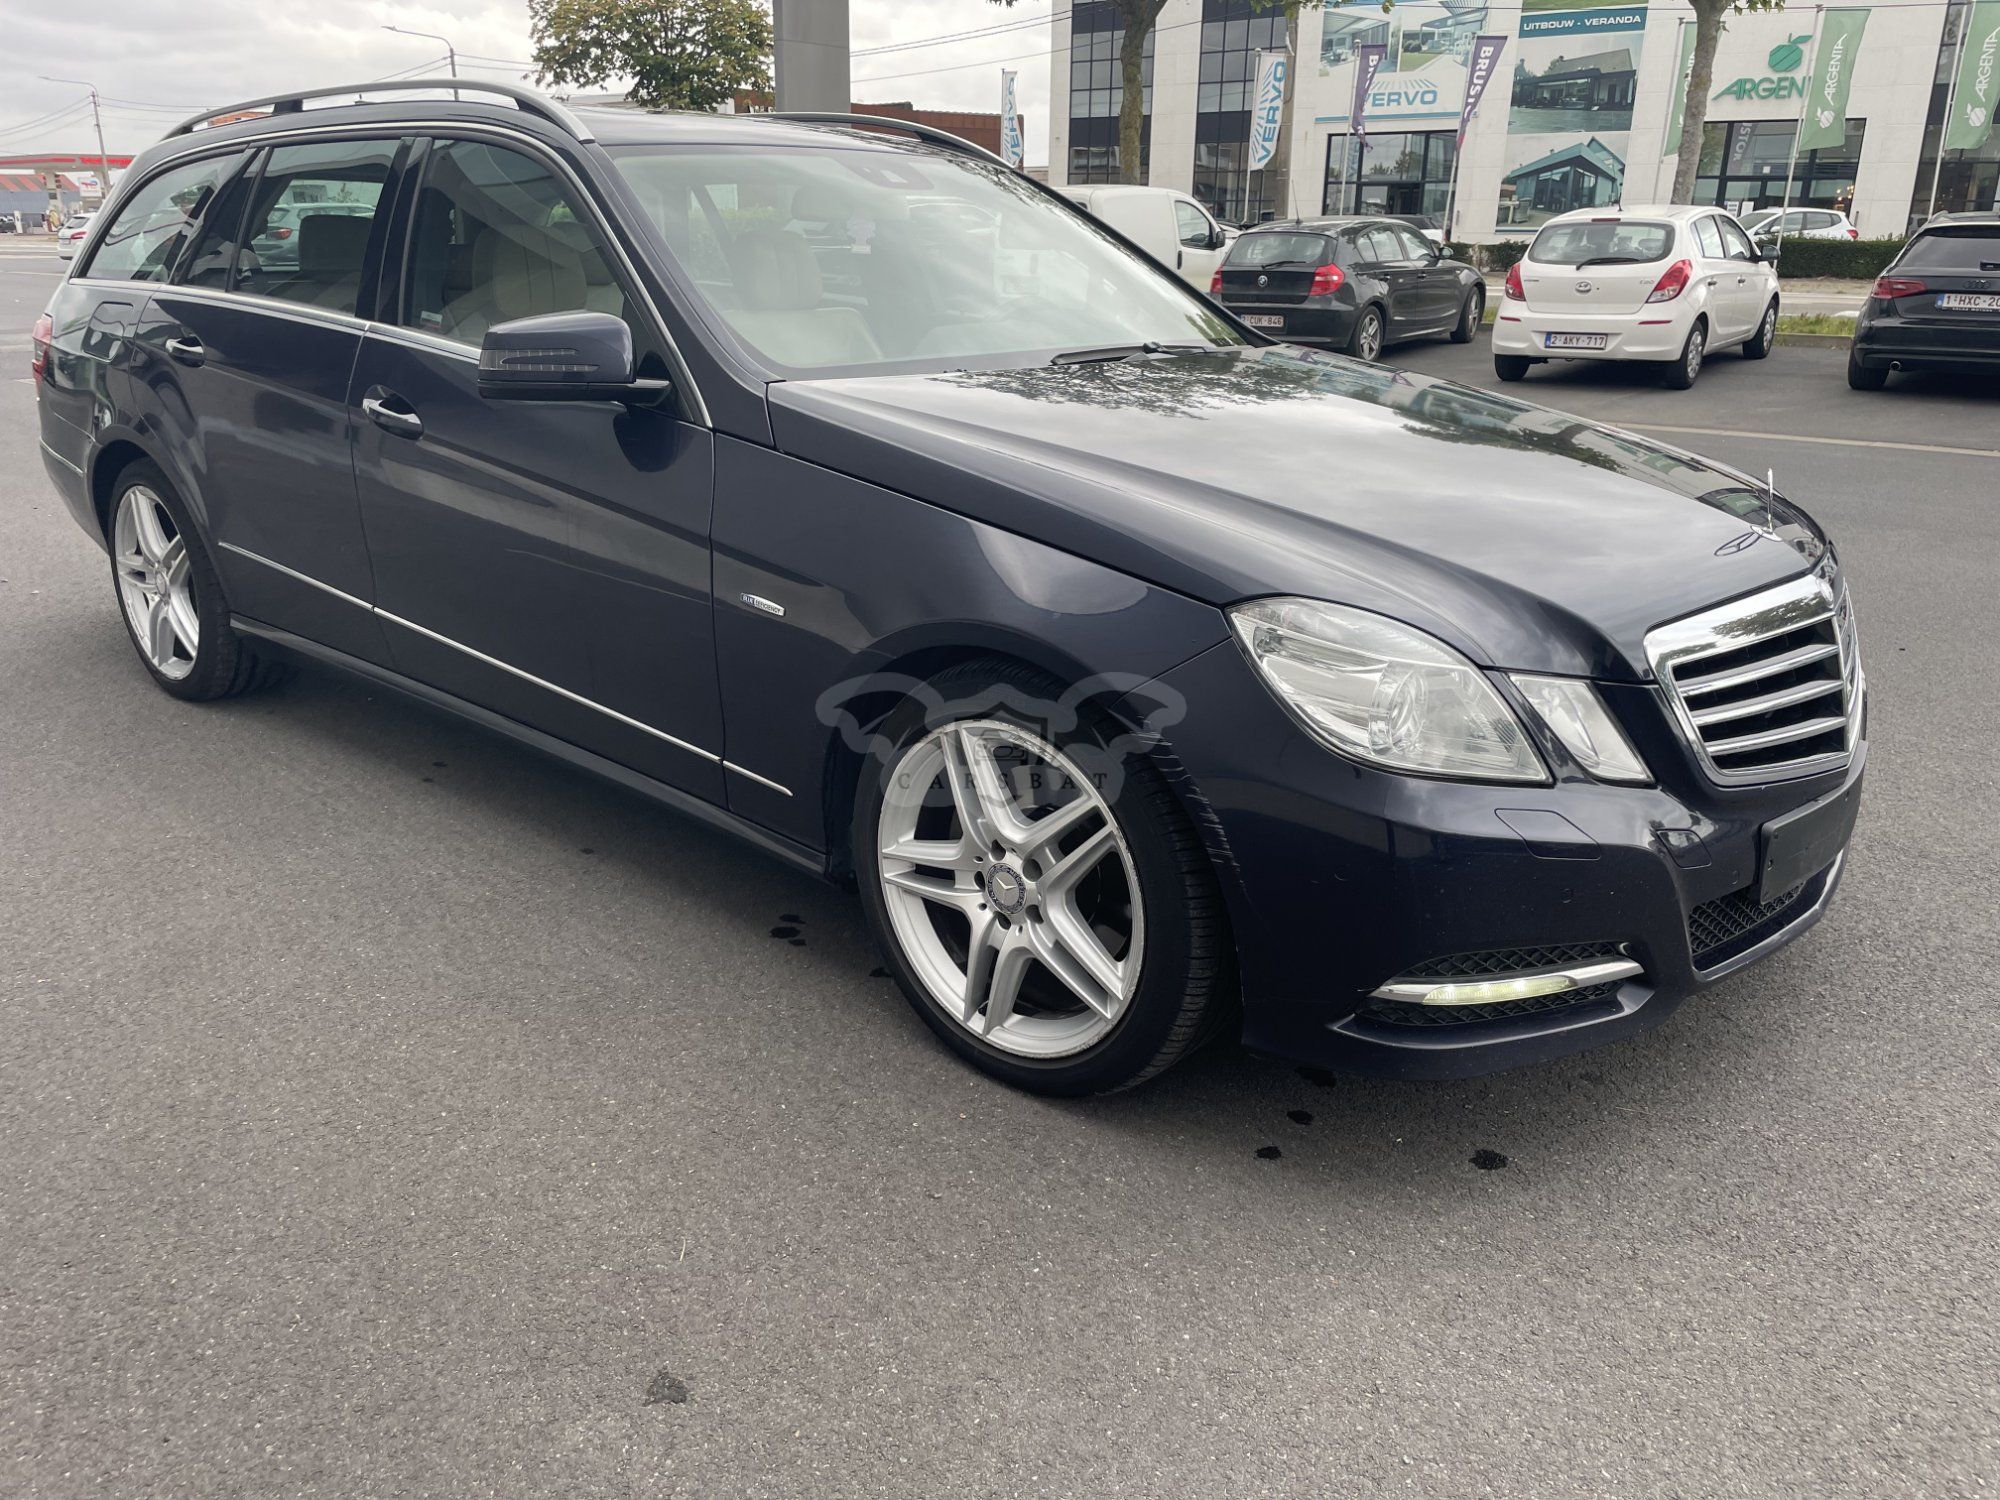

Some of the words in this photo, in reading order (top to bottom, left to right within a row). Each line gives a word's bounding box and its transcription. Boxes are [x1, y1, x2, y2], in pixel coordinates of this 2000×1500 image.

[1523, 20, 1575, 30] UITBOUW
[1584, 15, 1642, 26] VERANDA
[1711, 76, 1812, 101] ARGEN
[1824, 32, 1848, 107] ARGENTA
[1257, 60, 1287, 163] VERVO
